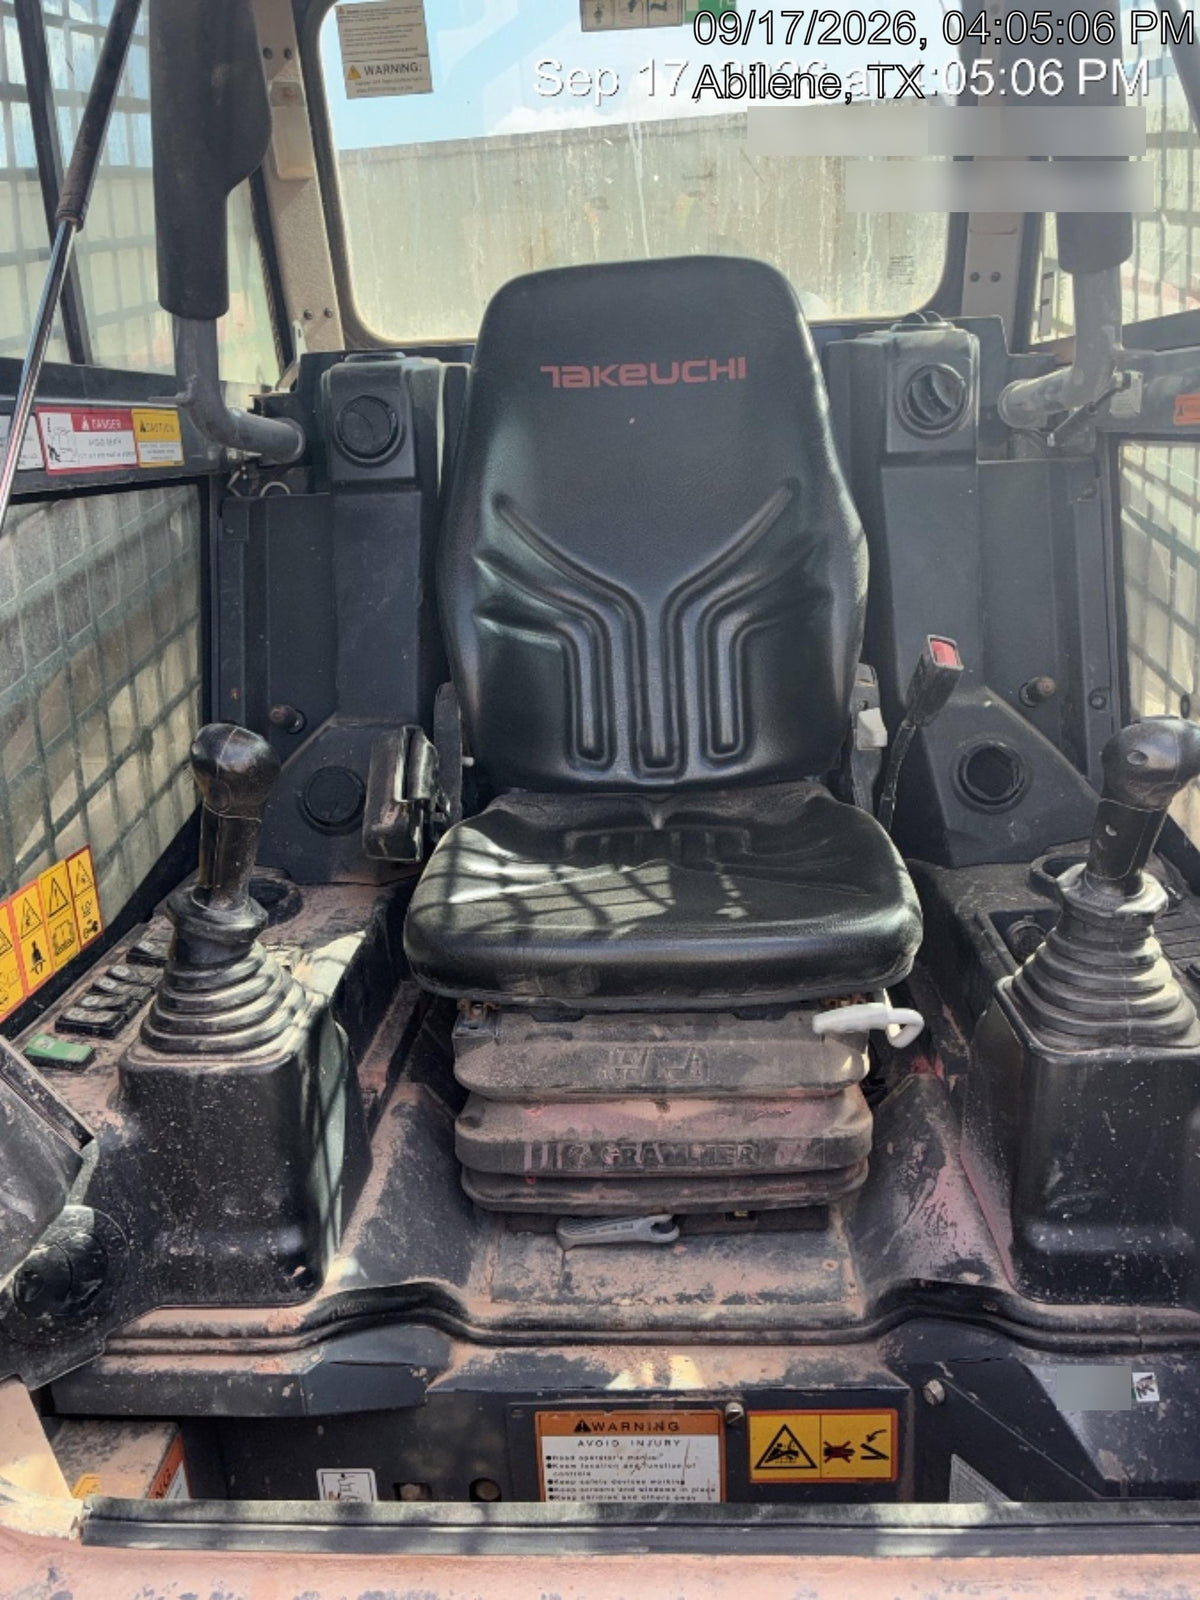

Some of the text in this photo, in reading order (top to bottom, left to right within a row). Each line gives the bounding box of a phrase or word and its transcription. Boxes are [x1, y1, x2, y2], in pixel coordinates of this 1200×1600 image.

[591, 1421, 680, 1432] WARNING
[577, 1439, 681, 1448] AVOID INJURY
